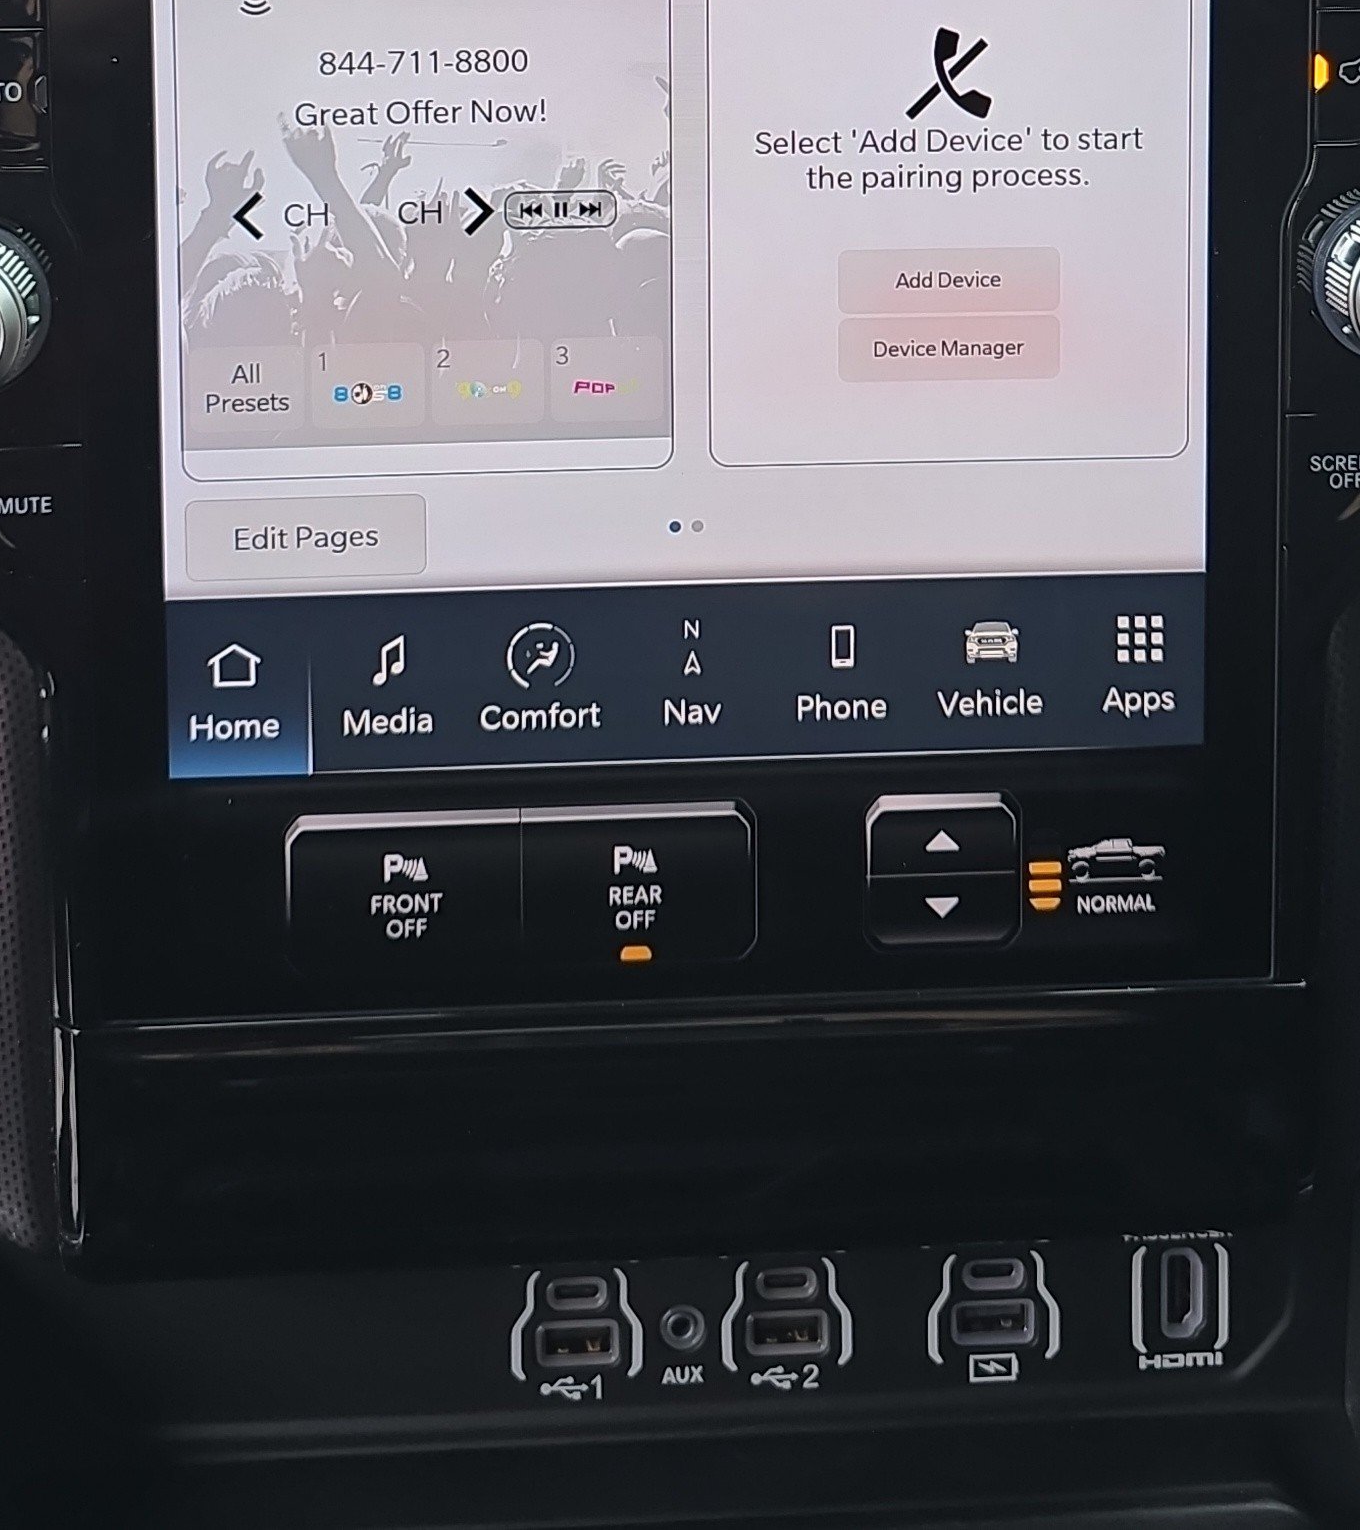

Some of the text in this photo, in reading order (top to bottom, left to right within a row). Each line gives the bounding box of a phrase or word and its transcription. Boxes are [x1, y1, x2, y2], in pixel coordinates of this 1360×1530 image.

[319, 49, 529, 76] 844-711-8800
[295, 99, 548, 127] Great Offer Now!
[755, 127, 1143, 154] Select 'Add Device' to start
[806, 164, 1090, 195] the pairing process.
[283, 203, 330, 228] CH
[398, 201, 443, 226] CH
[896, 270, 1001, 290] Add Device
[319, 352, 327, 371] 1
[436, 349, 451, 369] 2
[556, 346, 570, 366] 3
[873, 340, 1024, 361] Device Manager
[232, 363, 261, 384] All
[205, 391, 290, 414] Presets
[234, 525, 379, 554] Edit Pages
[684, 620, 700, 638] N
[663, 699, 722, 726] Nav
[797, 694, 888, 721] Phone
[937, 689, 1043, 717] Vehicle
[1102, 686, 1175, 718] Apps
[189, 713, 280, 741] Home
[343, 708, 433, 736] Media
[480, 701, 601, 731] Comfort
[371, 893, 442, 914] FRONT
[609, 886, 662, 906] REAR
[1077, 894, 1156, 914] NORMAL
[386, 917, 427, 939] OFF
[615, 909, 656, 930] OFF
[1139, 1351, 1223, 1370] HDMI
[661, 1363, 704, 1385] AUX
[802, 1364, 820, 1389] 2
[591, 1375, 602, 1400] 1
